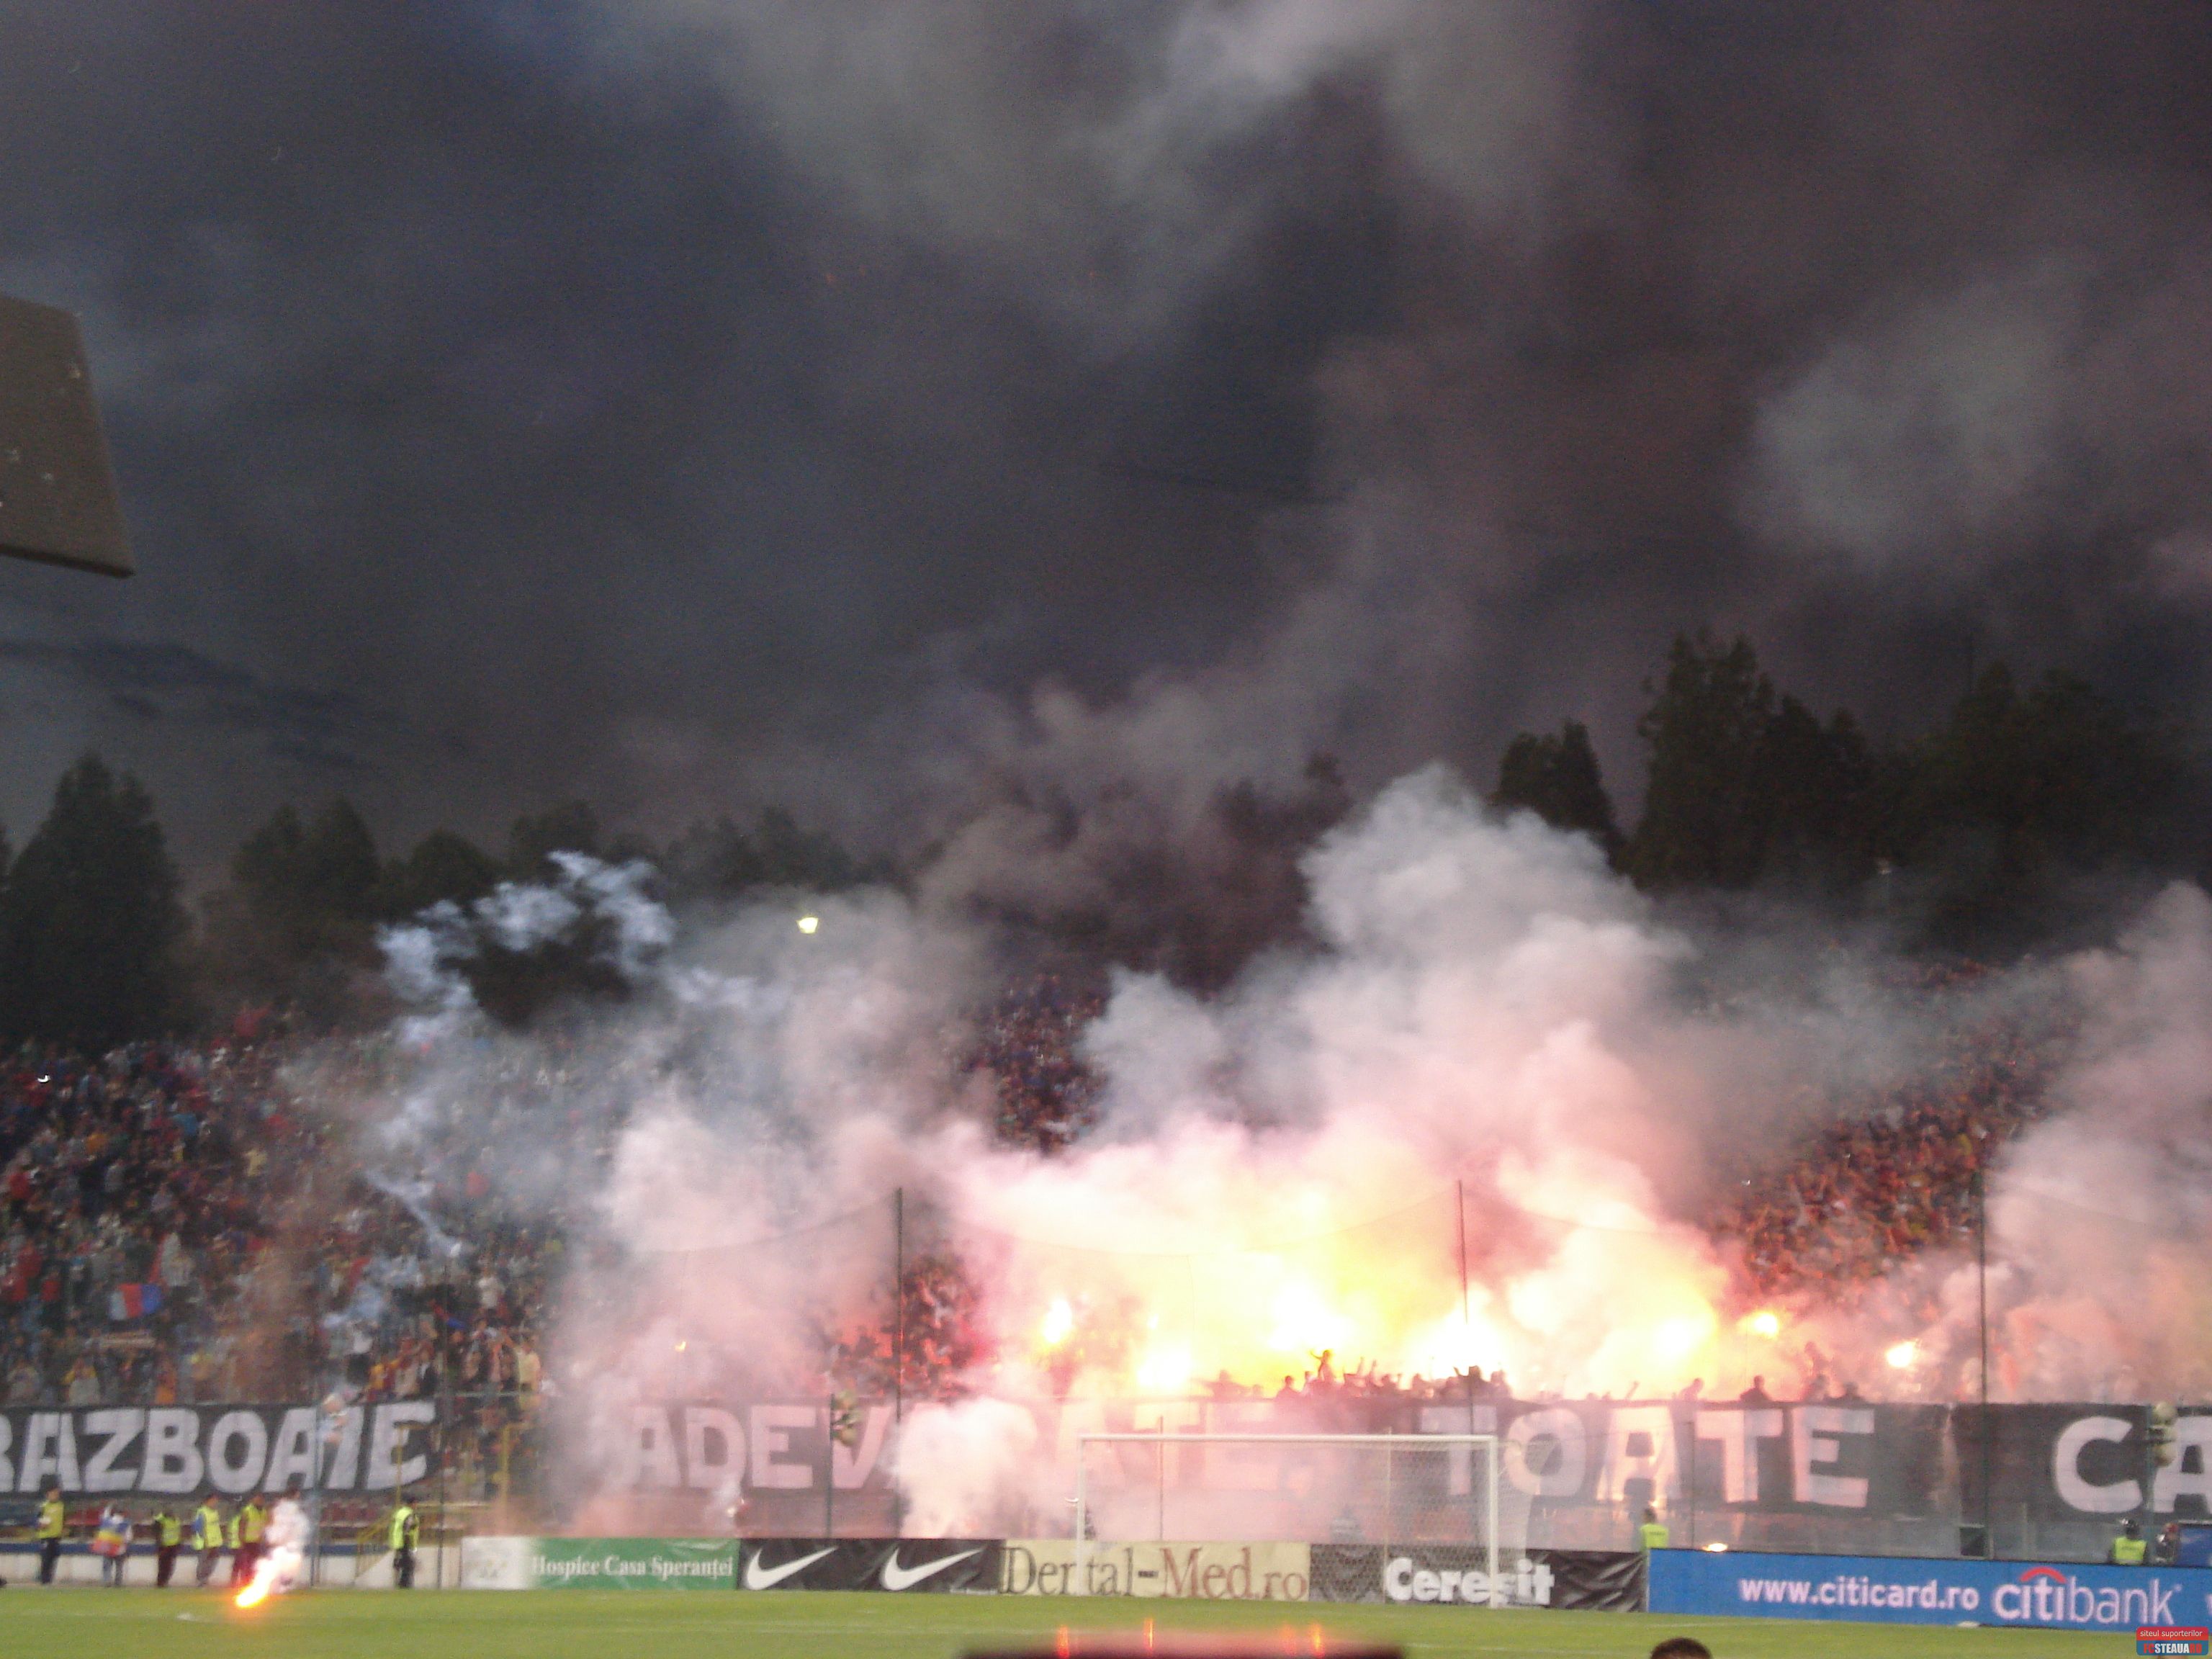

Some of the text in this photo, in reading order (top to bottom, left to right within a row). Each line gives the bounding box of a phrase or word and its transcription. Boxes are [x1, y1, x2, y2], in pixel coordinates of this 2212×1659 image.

[1420, 1406, 1874, 1507] TOATE
[531, 1555, 600, 1581] Hospice
[604, 1555, 647, 1575] Casa
[1385, 1557, 1555, 1605] Ceresit
[1740, 1575, 1979, 1610] www.citicard.ro
[1993, 1575, 2175, 1624] citibank
